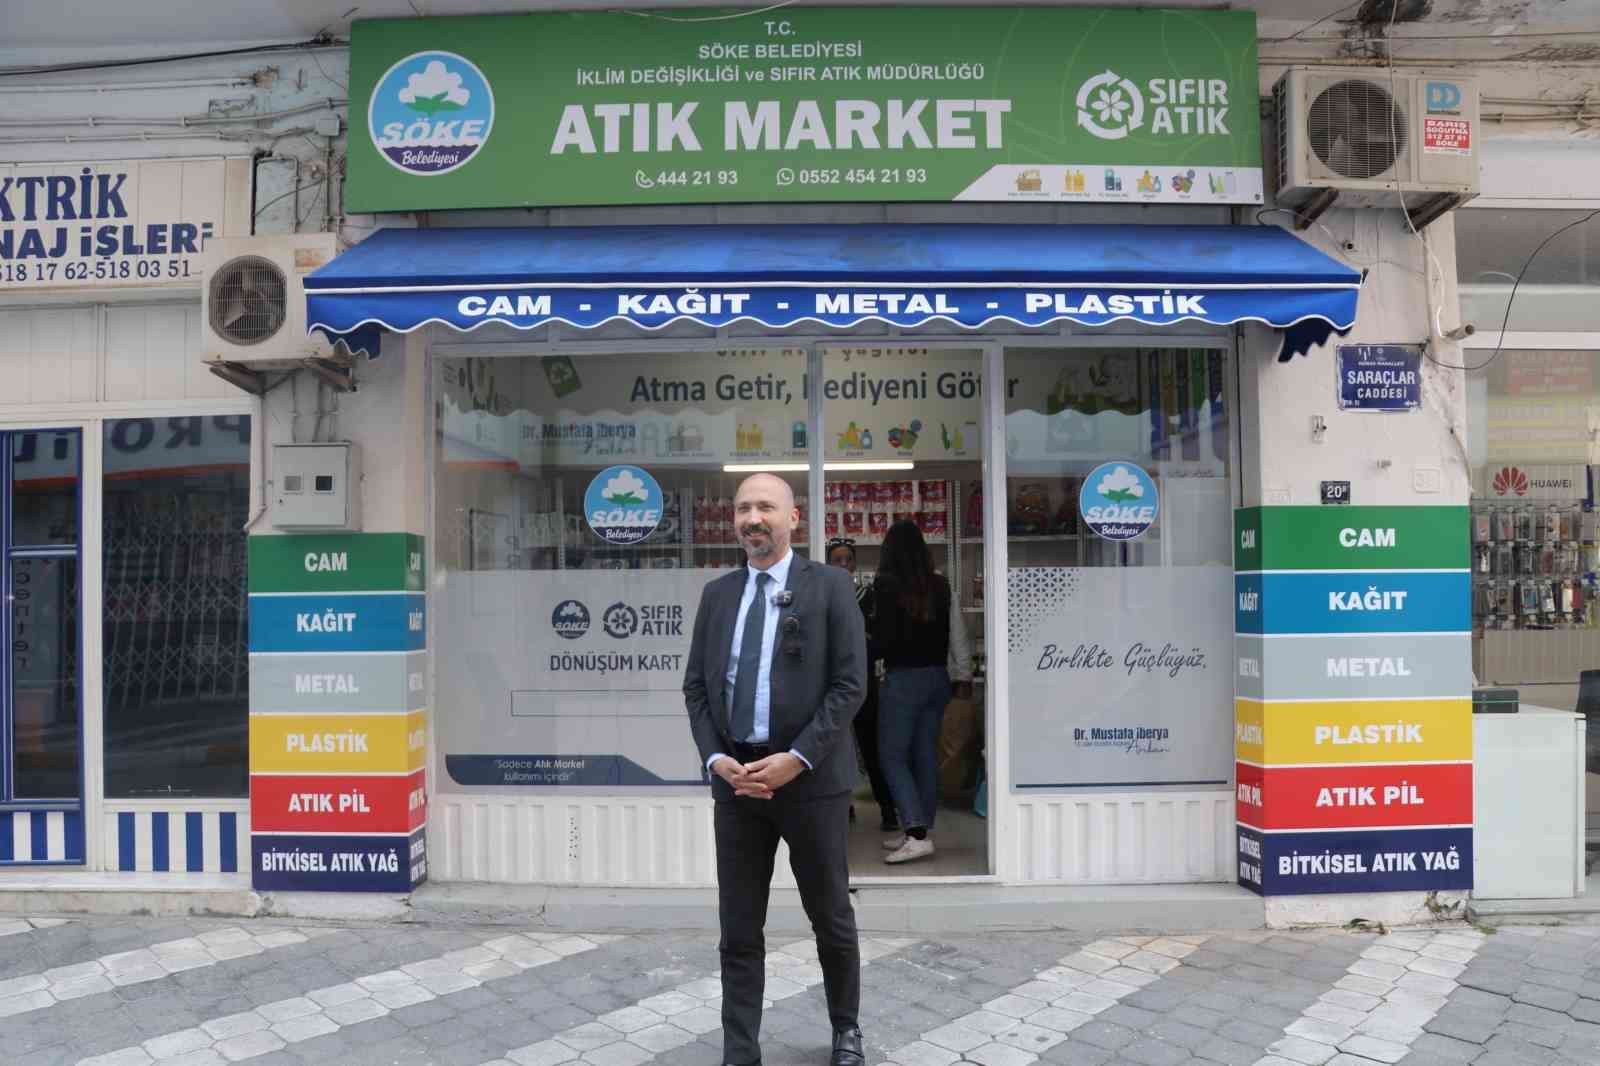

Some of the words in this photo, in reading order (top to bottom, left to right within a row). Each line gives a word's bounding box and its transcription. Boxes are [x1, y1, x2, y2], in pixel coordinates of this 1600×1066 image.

[764, 21, 796, 36] T.C.
[698, 44, 749, 60] SÖKE
[755, 40, 863, 58] BELEDİYESİ
[576, 69, 625, 86] İKLİM
[630, 66, 740, 86] DEĞİŞİKLİĞİ
[745, 72, 765, 82] ve
[769, 66, 816, 81] SIFIR
[820, 65, 863, 80] ATIK
[866, 63, 985, 81] MÜDÜRLÜĞÜ
[1148, 78, 1229, 105] SIFIR
[550, 101, 703, 155] ATIK
[724, 99, 1012, 151] MARKET
[1151, 106, 1230, 135] ATIK
[382, 118, 484, 146] SÖKE
[401, 150, 461, 168] Belediyesi
[657, 171, 691, 186] 444
[693, 171, 713, 186] 21
[717, 170, 739, 185] 93
[798, 170, 841, 185] 0552
[845, 170, 877, 184] 454
[880, 169, 901, 184] 21
[905, 169, 928, 184] 93
[35, 263, 58, 281] 17
[65, 260, 131, 280] 62-518
[137, 260, 161, 278] 03
[168, 259, 191, 278] 51
[457, 295, 551, 317] CAM
[617, 288, 751, 315] KAĞIT
[815, 294, 960, 314] METAL
[1026, 290, 1209, 315] PLASTİK
[630, 376, 706, 402] Atma
[714, 373, 792, 404] Getir,
[802, 370, 929, 407] ediyeni
[936, 371, 1020, 400] Götr
[1347, 370, 1416, 388] SARAÇLAR
[1357, 386, 1408, 399] CADDESİ
[1530, 479, 1572, 489] HUAWEI
[591, 507, 659, 527] SÖKE
[1087, 504, 1155, 523] SÖKE
[1102, 525, 1139, 537] Belediyesi
[1241, 529, 1255, 549] CAM
[1339, 527, 1396, 548] CAM
[304, 552, 348, 572] CAM
[1328, 585, 1407, 611] KAĞIT
[296, 608, 357, 632] KAĞIT
[641, 605, 683, 620] SIFIR
[641, 621, 683, 636] ATIK
[550, 650, 633, 676] DÖNÜŞÜM
[638, 654, 683, 671] KART
[1036, 643, 1114, 671] Birlikte
[1124, 642, 1207, 678] Güçlüyüz.
[1326, 657, 1412, 677] METAL
[295, 674, 360, 694] METAL
[286, 729, 369, 753] PLASTİK
[1091, 727, 1134, 740] Mustafa
[1314, 720, 1423, 745] PLASTİK
[553, 760, 585, 769] Market
[287, 793, 334, 813] ATIK
[339, 789, 371, 813] PİL
[1315, 787, 1376, 808] ATIK
[1383, 781, 1425, 805] PİL
[262, 848, 328, 872] BİTKİSEL
[330, 852, 365, 872] ATIK
[367, 849, 399, 873] YAĞ
[1278, 850, 1367, 876] BİTKİSEL
[1371, 854, 1416, 873] ATIK
[1422, 846, 1461, 871] YAĞ
